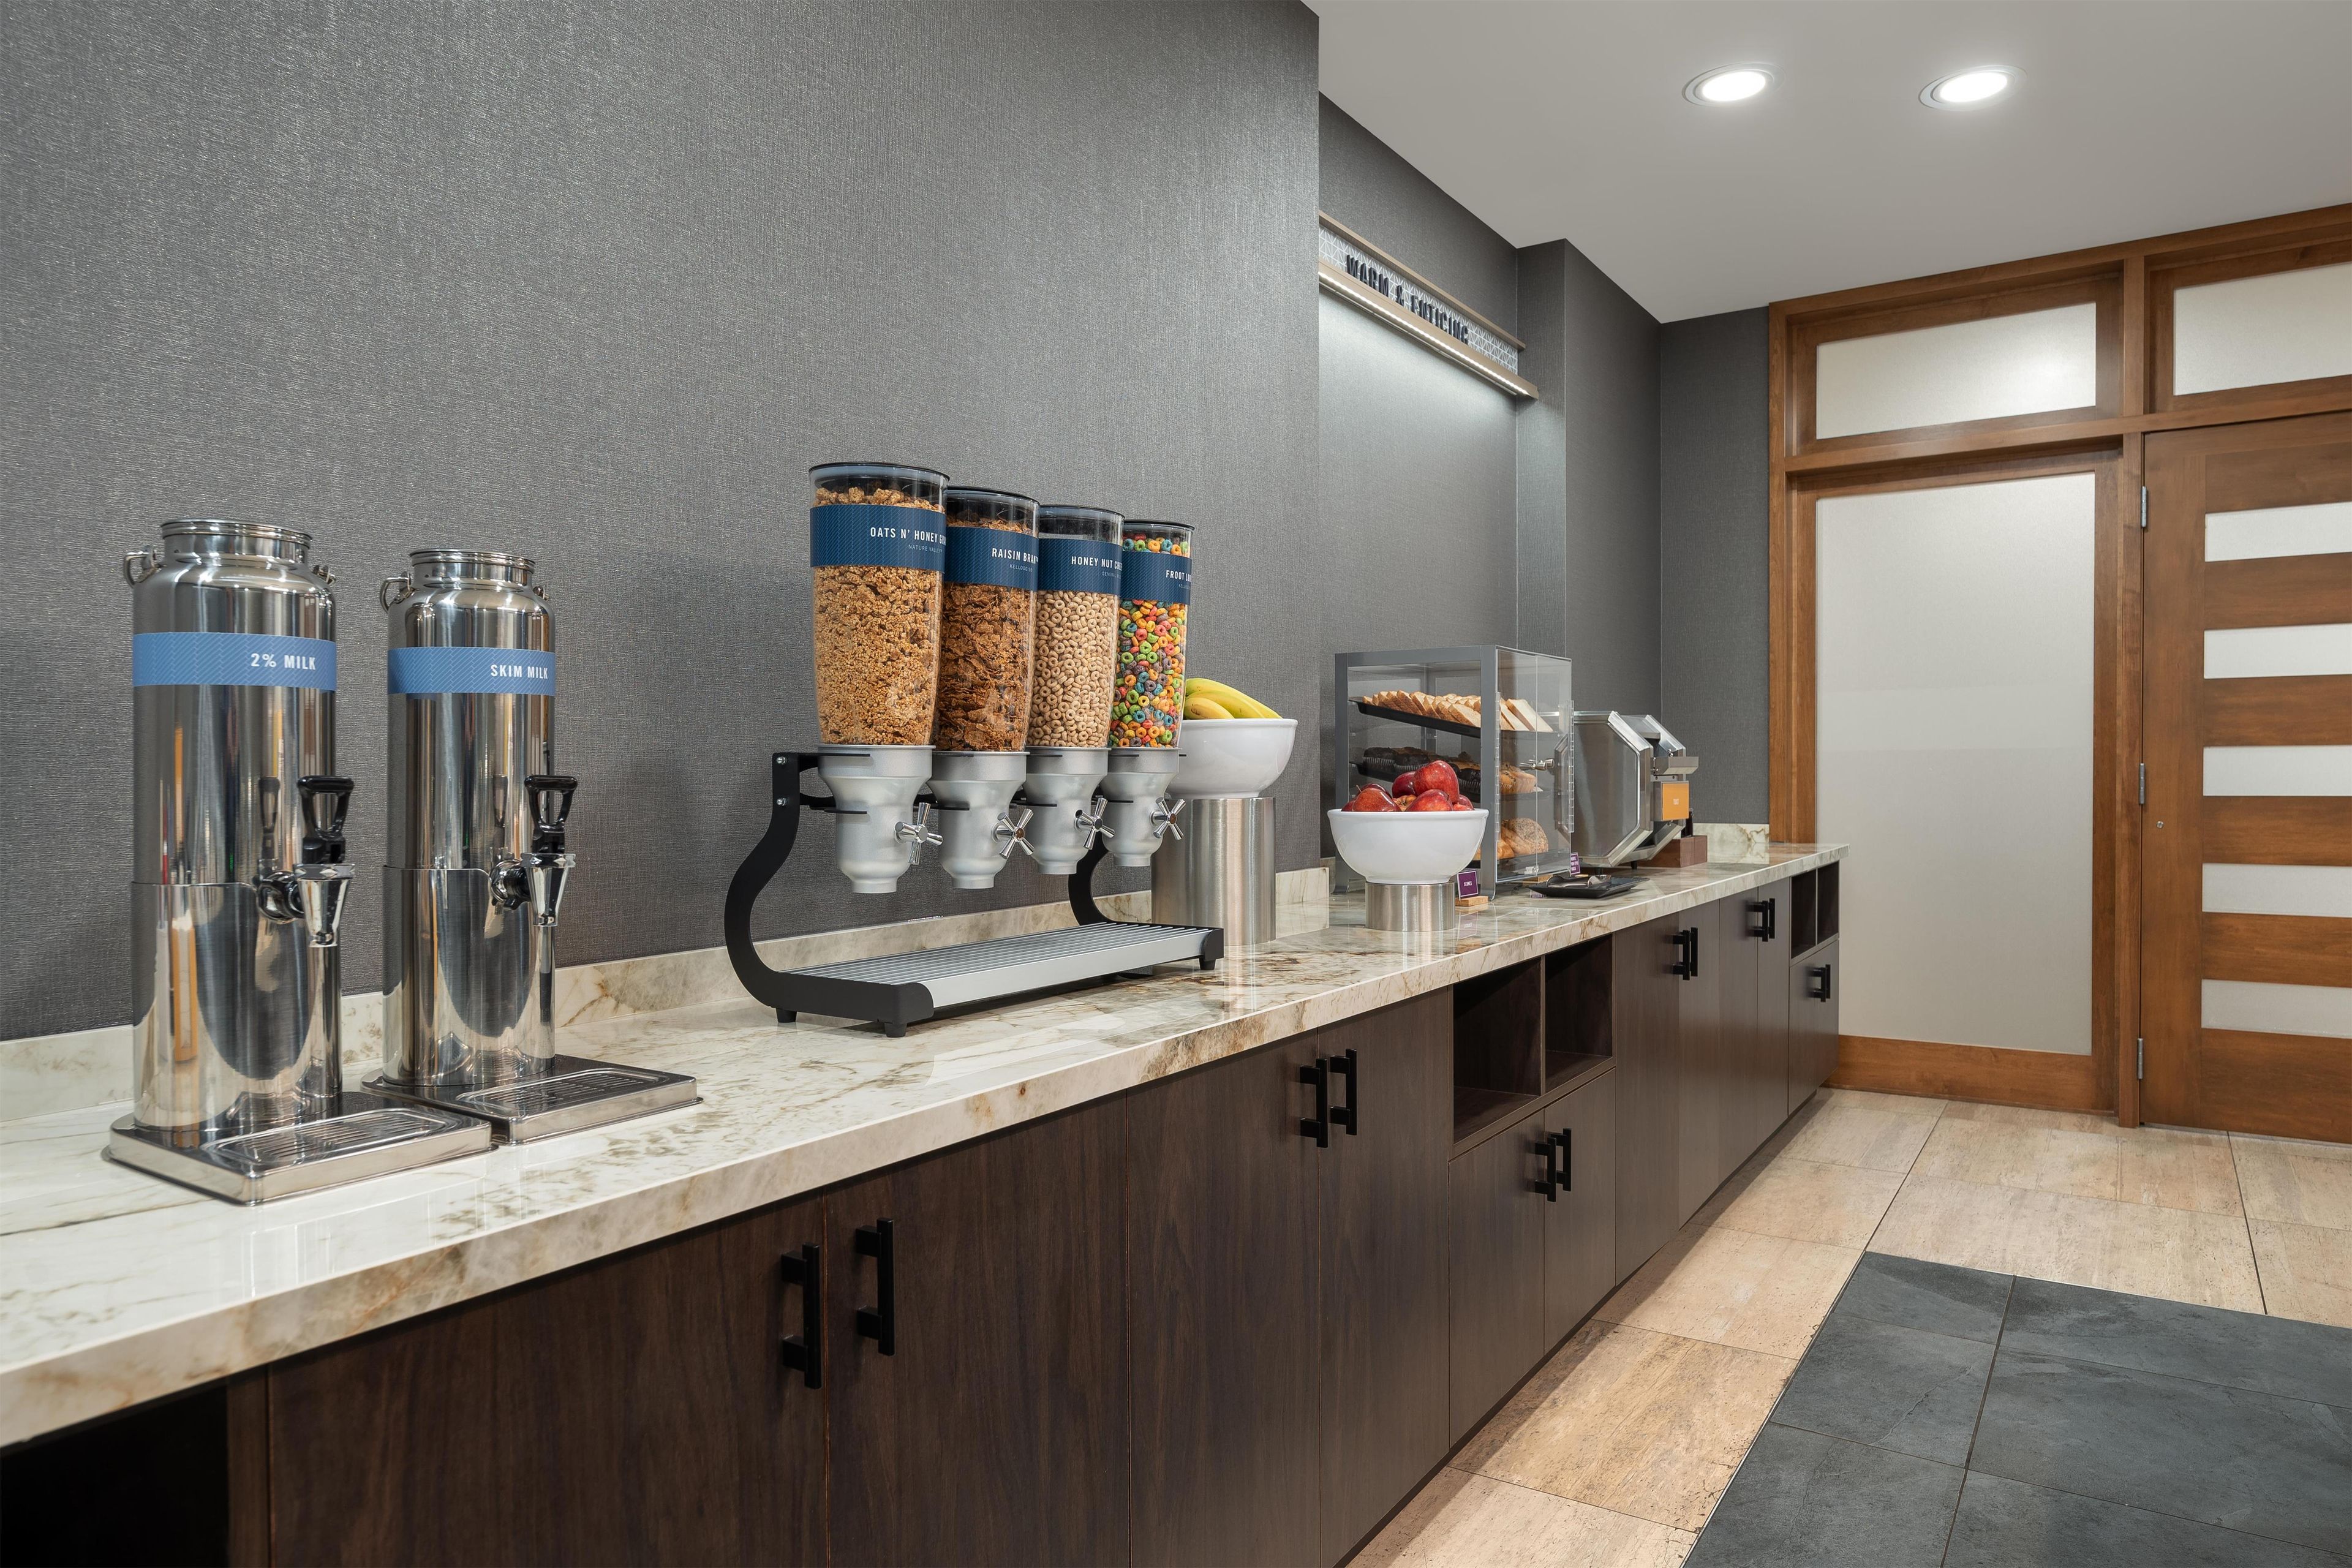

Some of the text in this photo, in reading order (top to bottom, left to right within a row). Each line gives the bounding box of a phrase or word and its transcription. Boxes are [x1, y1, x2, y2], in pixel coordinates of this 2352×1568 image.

[1347, 254, 1468, 345] WARM & ENTICING
[870, 527, 896, 538] OATS
[914, 530, 938, 543] HONEY
[992, 548, 1021, 560] RAISIN
[1071, 556, 1098, 567] HONEY
[1101, 558, 1113, 568] NUT
[1166, 570, 1185, 580] FROOT
[251, 653, 315, 670] 2% MILK
[491, 664, 548, 679] SKIM MILK
